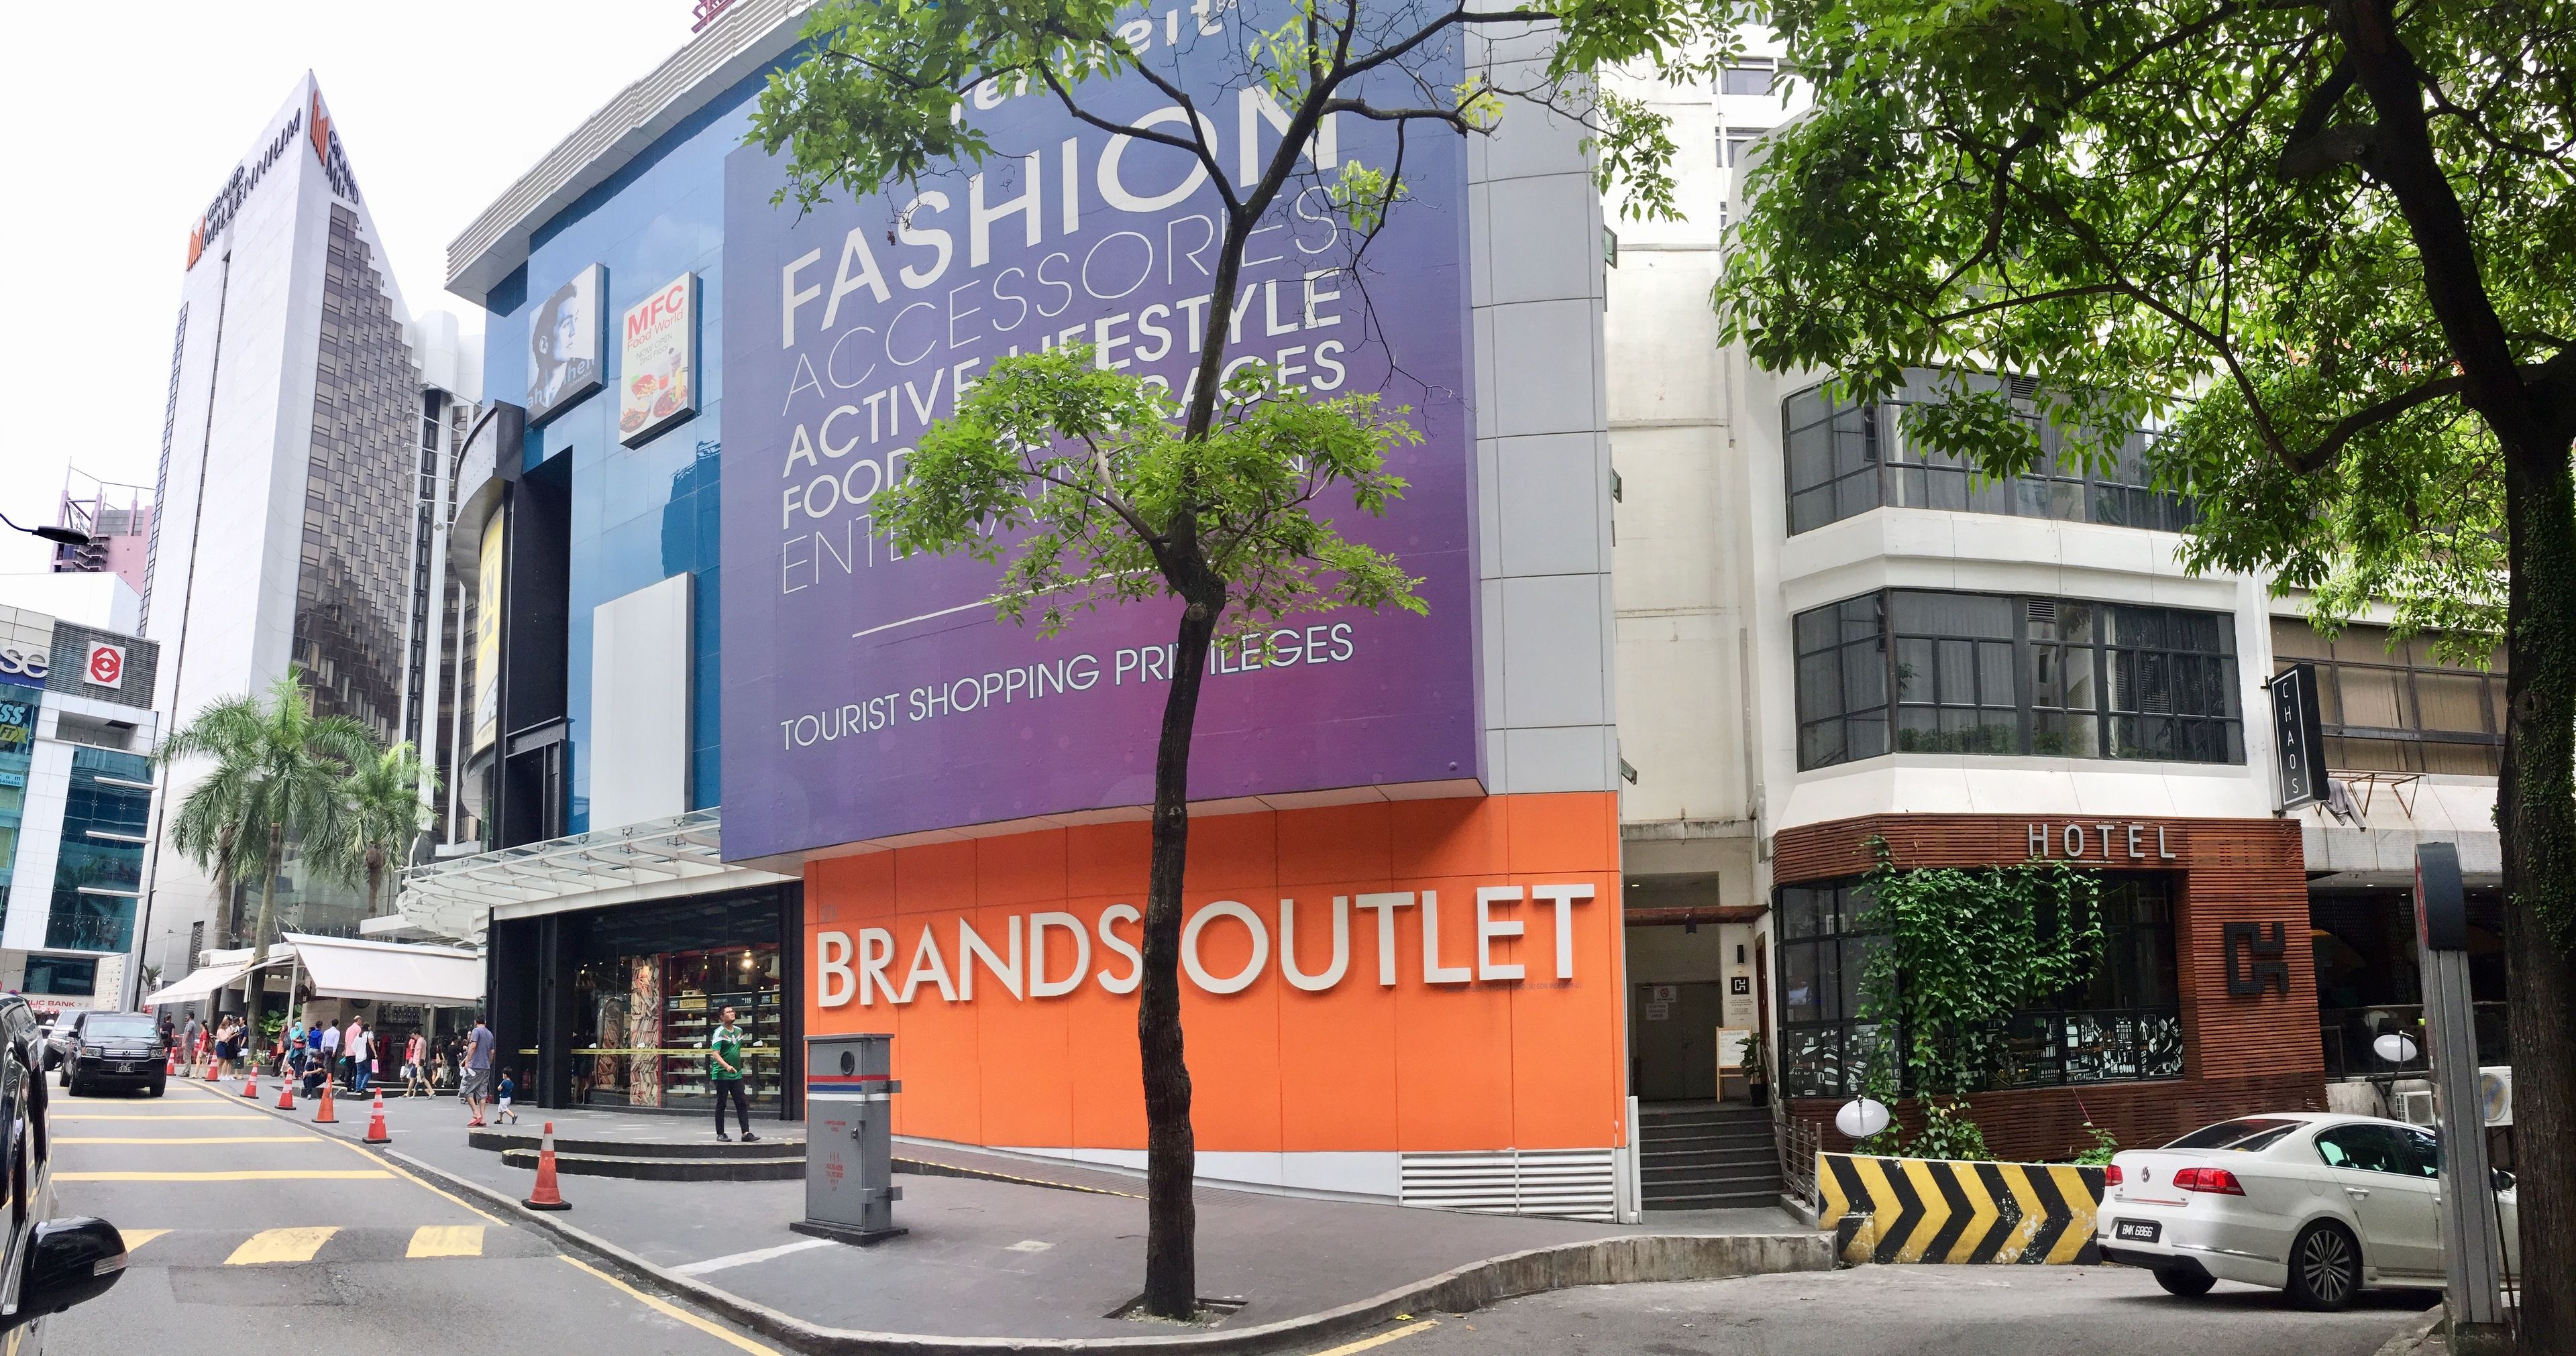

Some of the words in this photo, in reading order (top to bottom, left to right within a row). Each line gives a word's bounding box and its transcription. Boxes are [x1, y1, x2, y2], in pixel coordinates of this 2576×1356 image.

[203, 107, 301, 251] MILLENNIUM
[207, 166, 244, 221] GRAND
[329, 130, 359, 205] GRAND
[783, 70, 1337, 349] FASHION
[627, 328, 651, 352] Food
[654, 308, 683, 335] World
[628, 285, 684, 340] MFC
[783, 186, 1337, 416] ACCESSORIES
[1008, 267, 1341, 402] ESTYLE
[636, 344, 653, 360] NOW
[654, 333, 673, 349] OPEN
[639, 354, 652, 365] 2nd
[653, 343, 669, 356] Floor
[782, 357, 980, 478] ACTIVE
[783, 447, 916, 530] FOOD
[0, 702, 25, 724] SS
[780, 693, 900, 751] TOURIST
[908, 655, 1100, 722] SHOPPING
[1116, 623, 1354, 685] PRIILEGES
[2282, 681, 2300, 794] CHAOS
[2027, 823, 2177, 858] HOTEL
[817, 903, 1142, 1007] BRANDS
[1181, 883, 1595, 995] OUTLET
[2122, 1224, 2135, 1235] BMK
